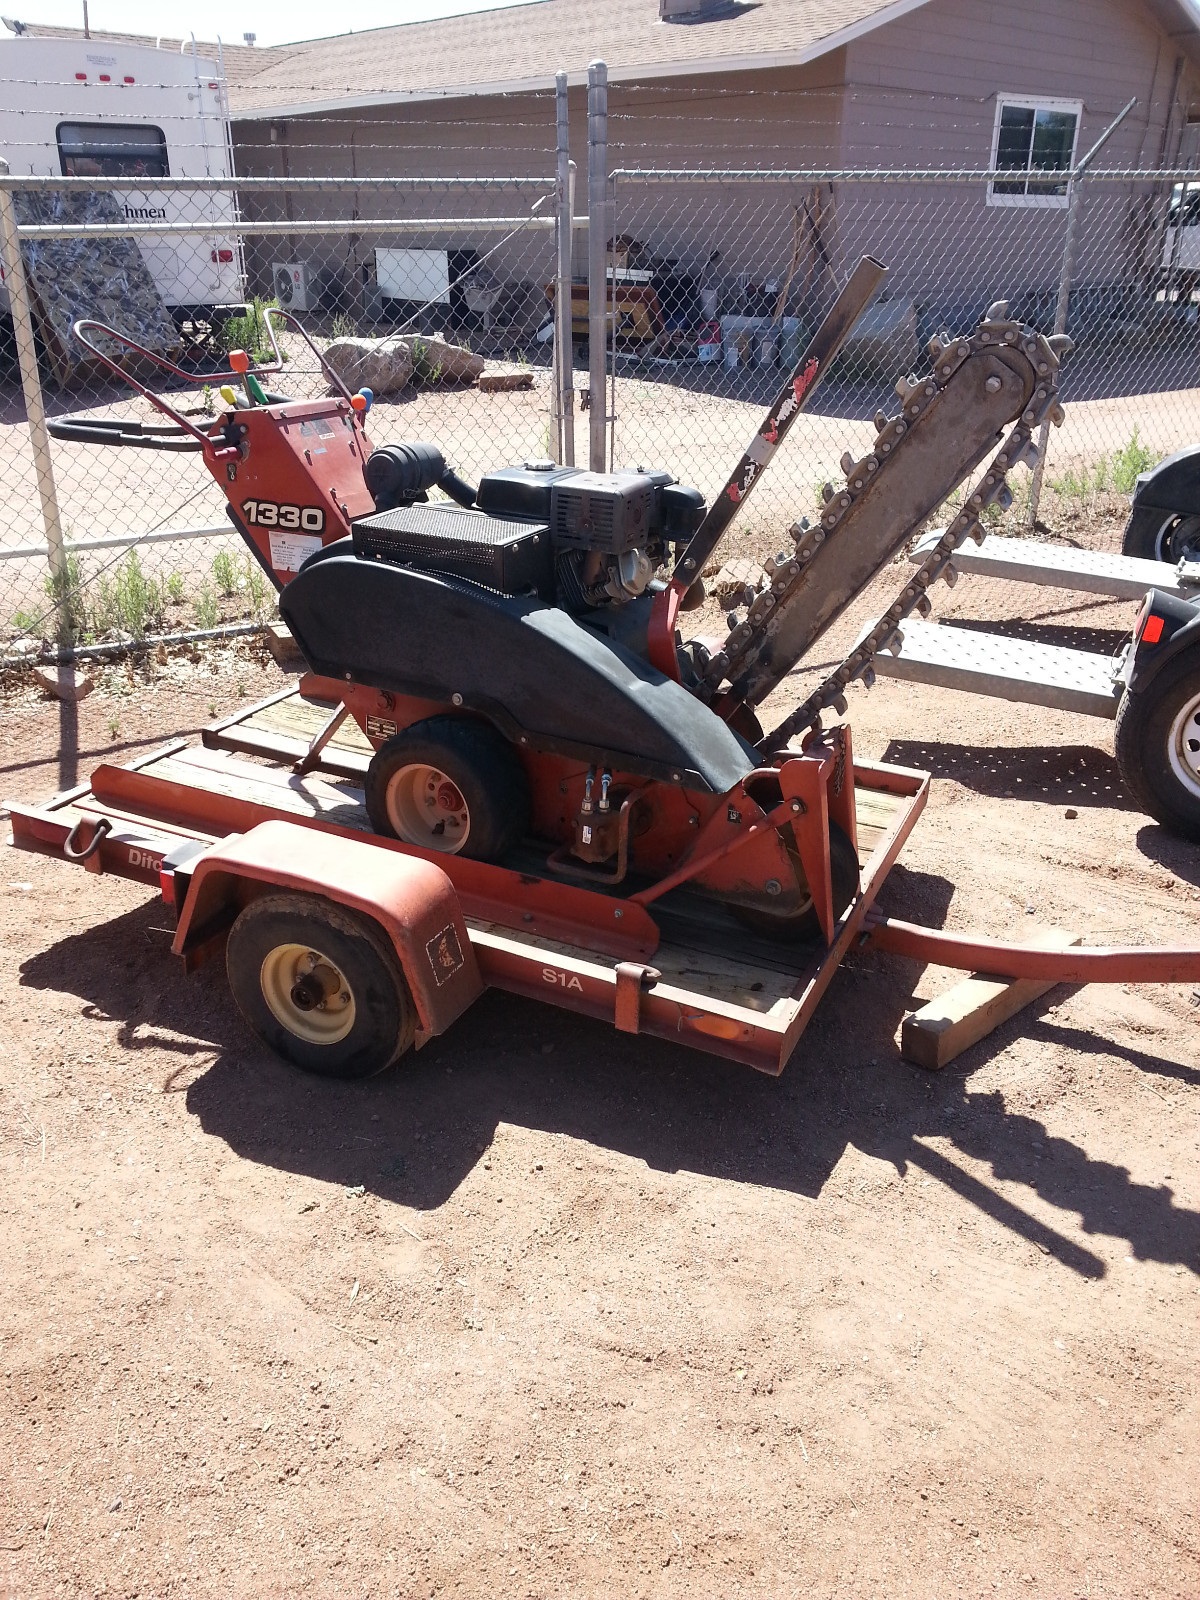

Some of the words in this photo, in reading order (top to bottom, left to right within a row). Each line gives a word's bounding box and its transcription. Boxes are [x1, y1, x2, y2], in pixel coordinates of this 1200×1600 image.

[242, 500, 324, 532] 1330
[128, 848, 163, 872] Ditc
[542, 968, 584, 992] S1A
